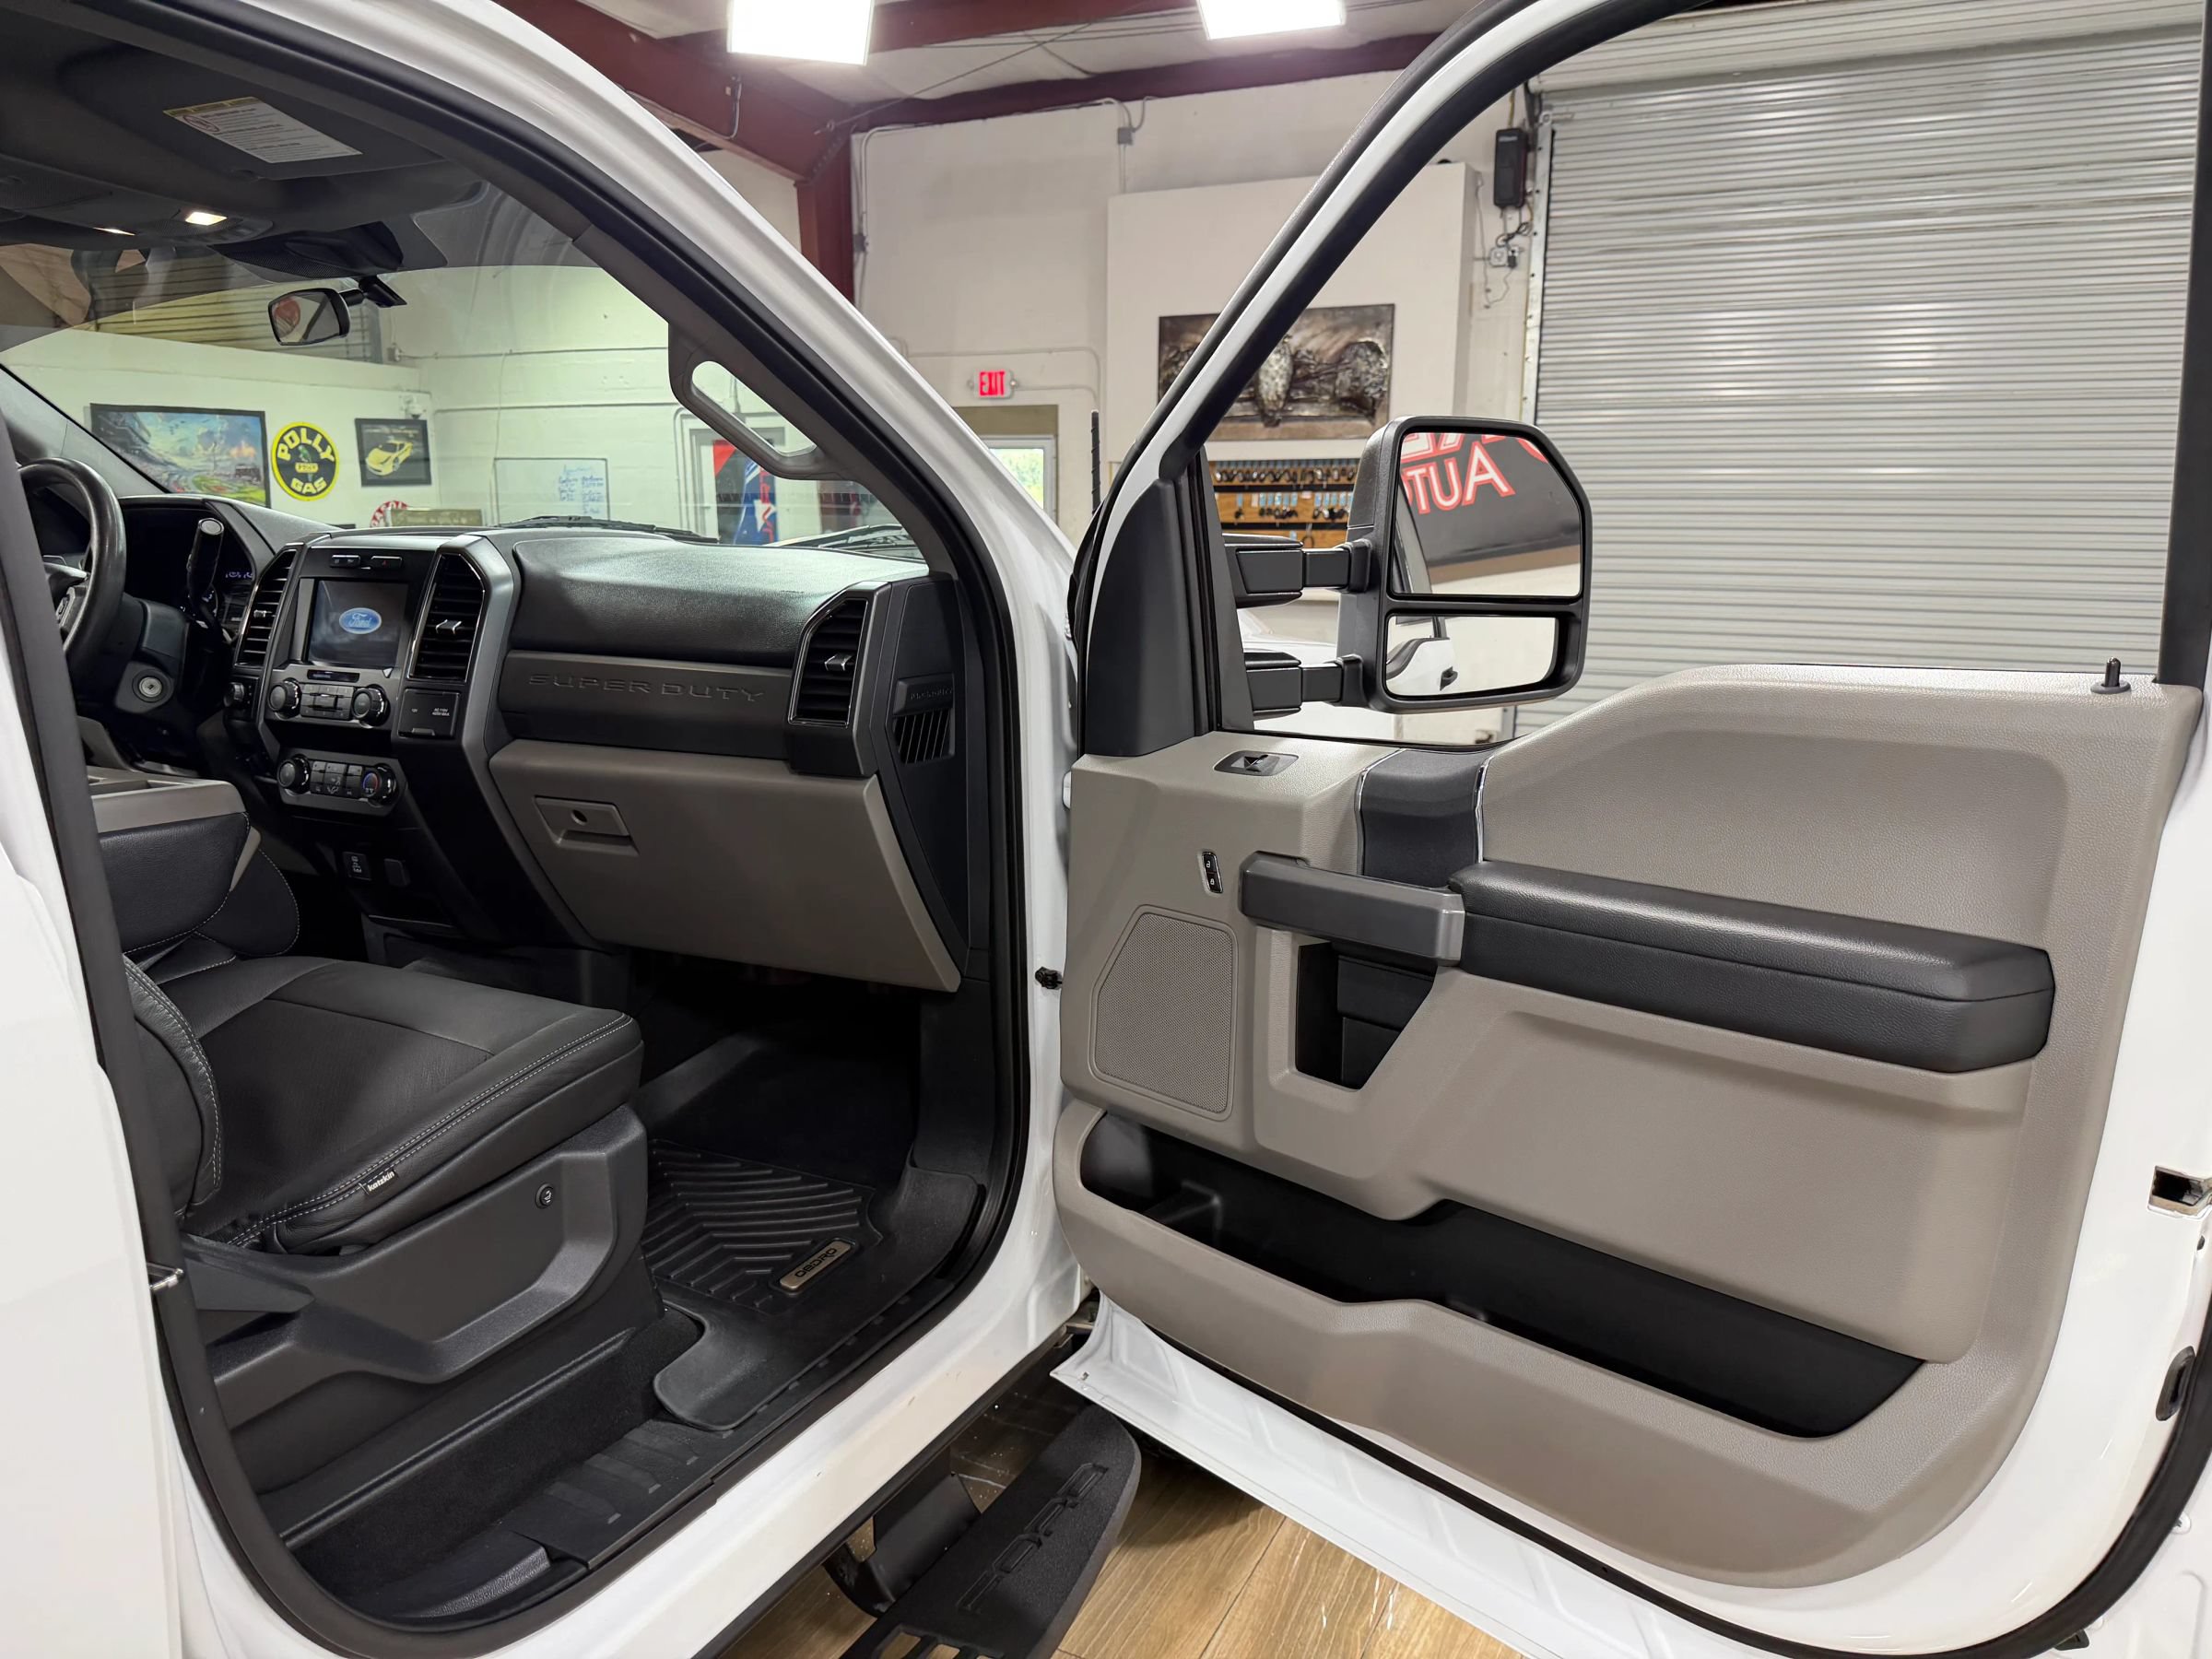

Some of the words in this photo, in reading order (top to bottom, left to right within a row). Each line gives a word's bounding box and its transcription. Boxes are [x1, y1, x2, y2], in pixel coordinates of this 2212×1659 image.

[980, 371, 1005, 396] EXIT
[277, 428, 335, 462] POLLY
[290, 477, 327, 494] GAS
[528, 673, 651, 694] SUPER
[661, 683, 764, 702] DUTY
[367, 1171, 395, 1192] katzkin
[956, 1462, 1109, 1614] FORD
